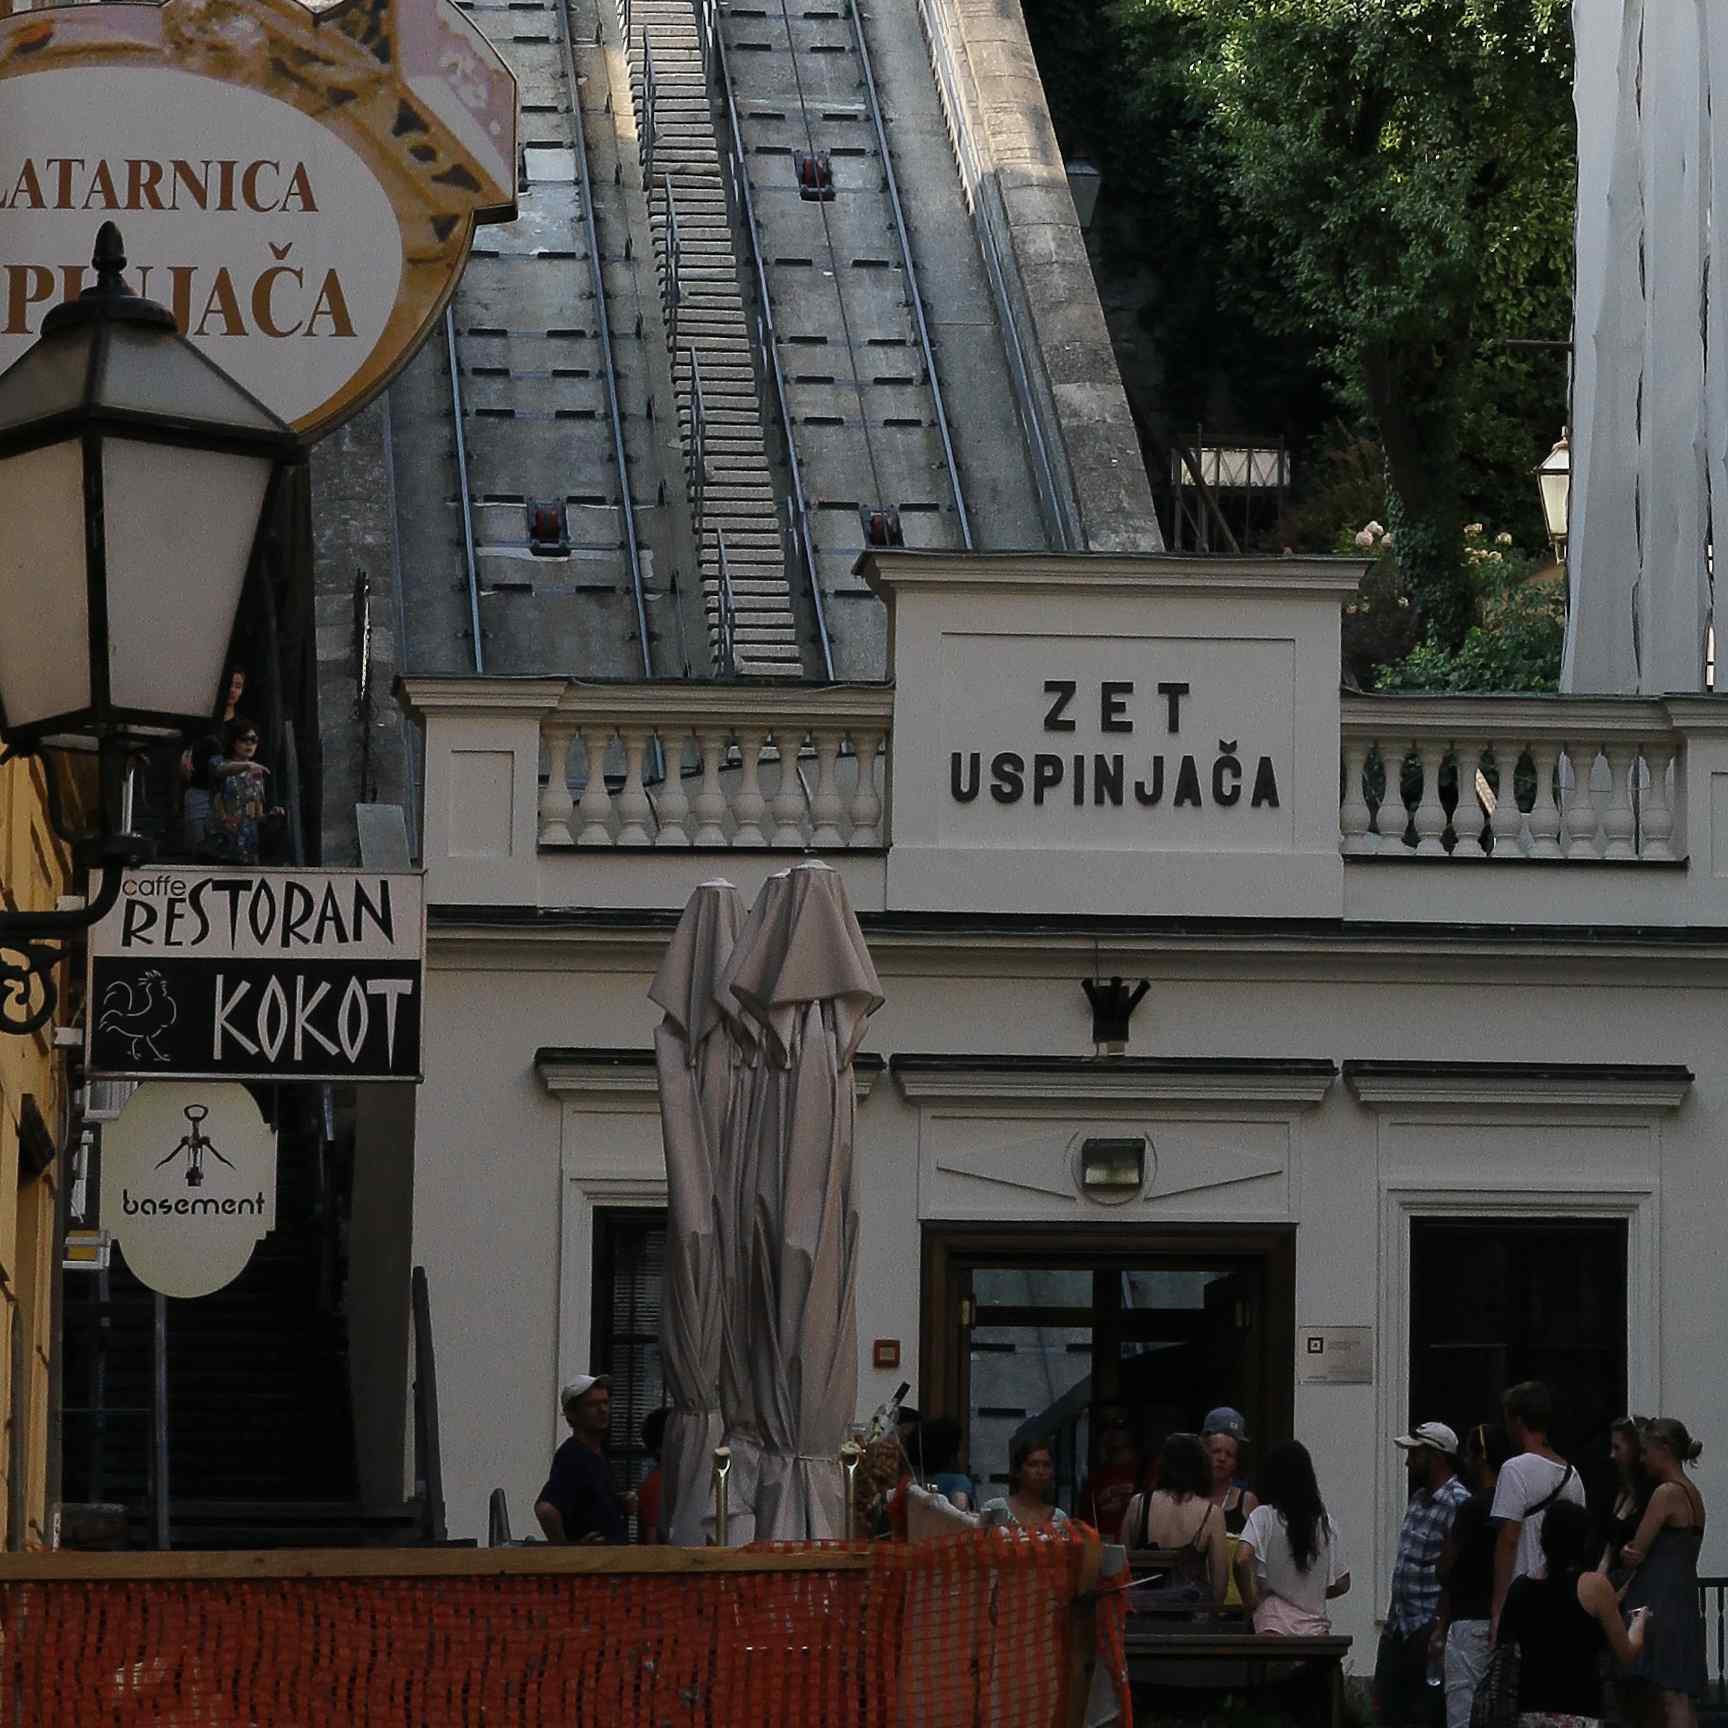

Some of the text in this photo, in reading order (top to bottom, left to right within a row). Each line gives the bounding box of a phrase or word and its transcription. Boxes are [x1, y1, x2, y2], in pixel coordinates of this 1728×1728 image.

[0, 158, 319, 213] ATARNICA
[1043, 680, 1191, 734] ZET
[950, 739, 1281, 808] USPINJAČA
[122, 875, 187, 897] caffe
[121, 877, 395, 951] RESTORAN
[213, 973, 414, 1070] KOKOT
[122, 1189, 266, 1216] basement
